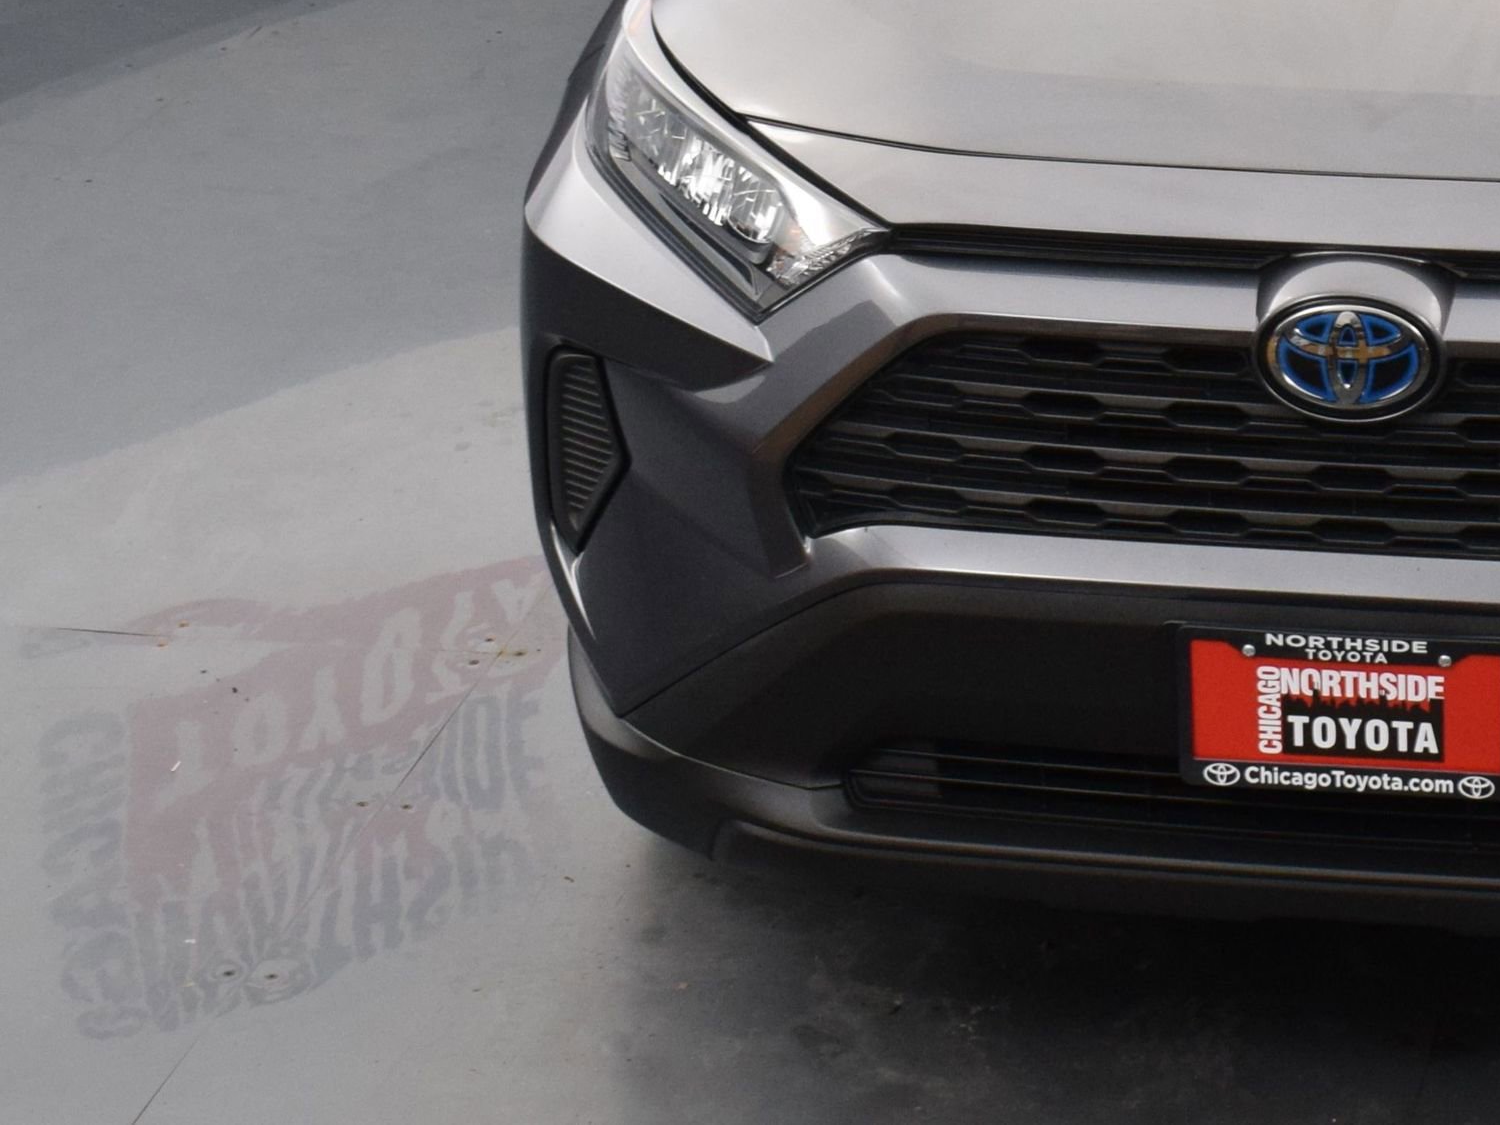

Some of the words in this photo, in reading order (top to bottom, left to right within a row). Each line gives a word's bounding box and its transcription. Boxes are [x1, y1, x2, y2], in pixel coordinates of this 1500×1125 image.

[1264, 632, 1429, 655] NORTHSIDE
[1304, 648, 1388, 664] TOYOTA
[1280, 666, 1445, 703] NORTHSIDE
[1256, 665, 1283, 755] CHICAGO
[1286, 714, 1440, 755] TOYOTA
[1244, 765, 1455, 794] ChicagoToyota.com
